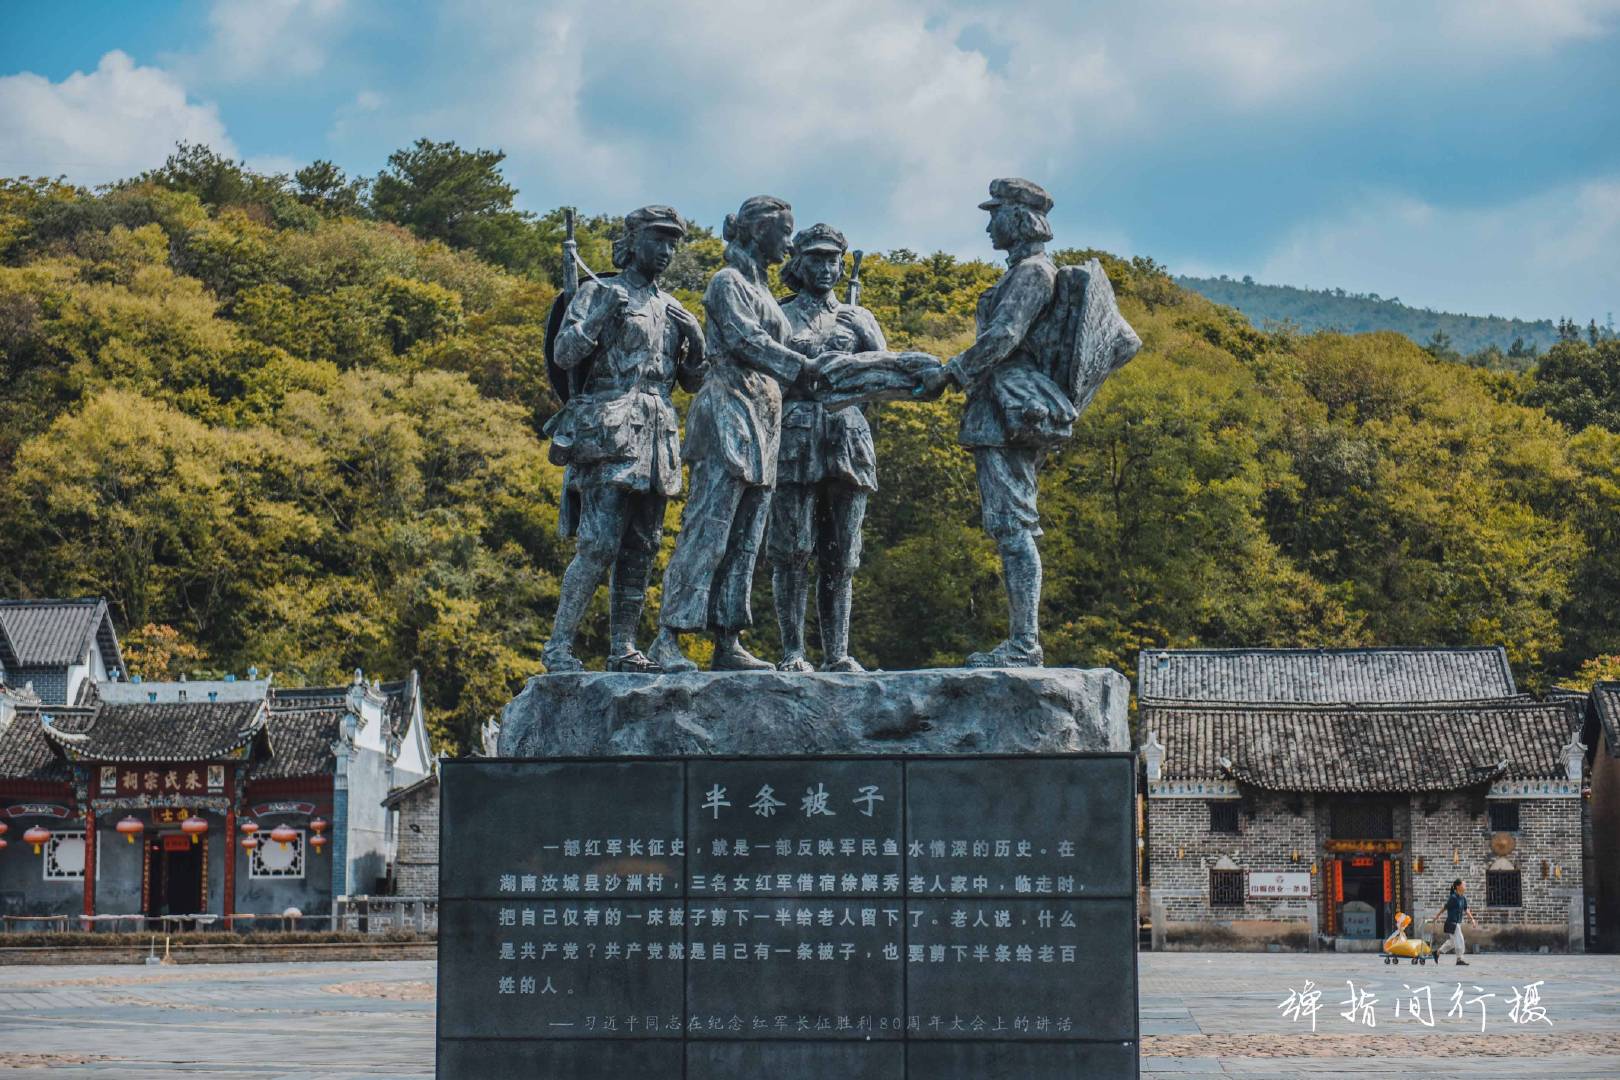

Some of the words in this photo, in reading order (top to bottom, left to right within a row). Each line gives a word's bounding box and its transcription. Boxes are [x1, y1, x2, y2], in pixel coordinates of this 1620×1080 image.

[701, 782, 885, 820] 半条被子
[498, 976, 575, 995] 姓的人。
